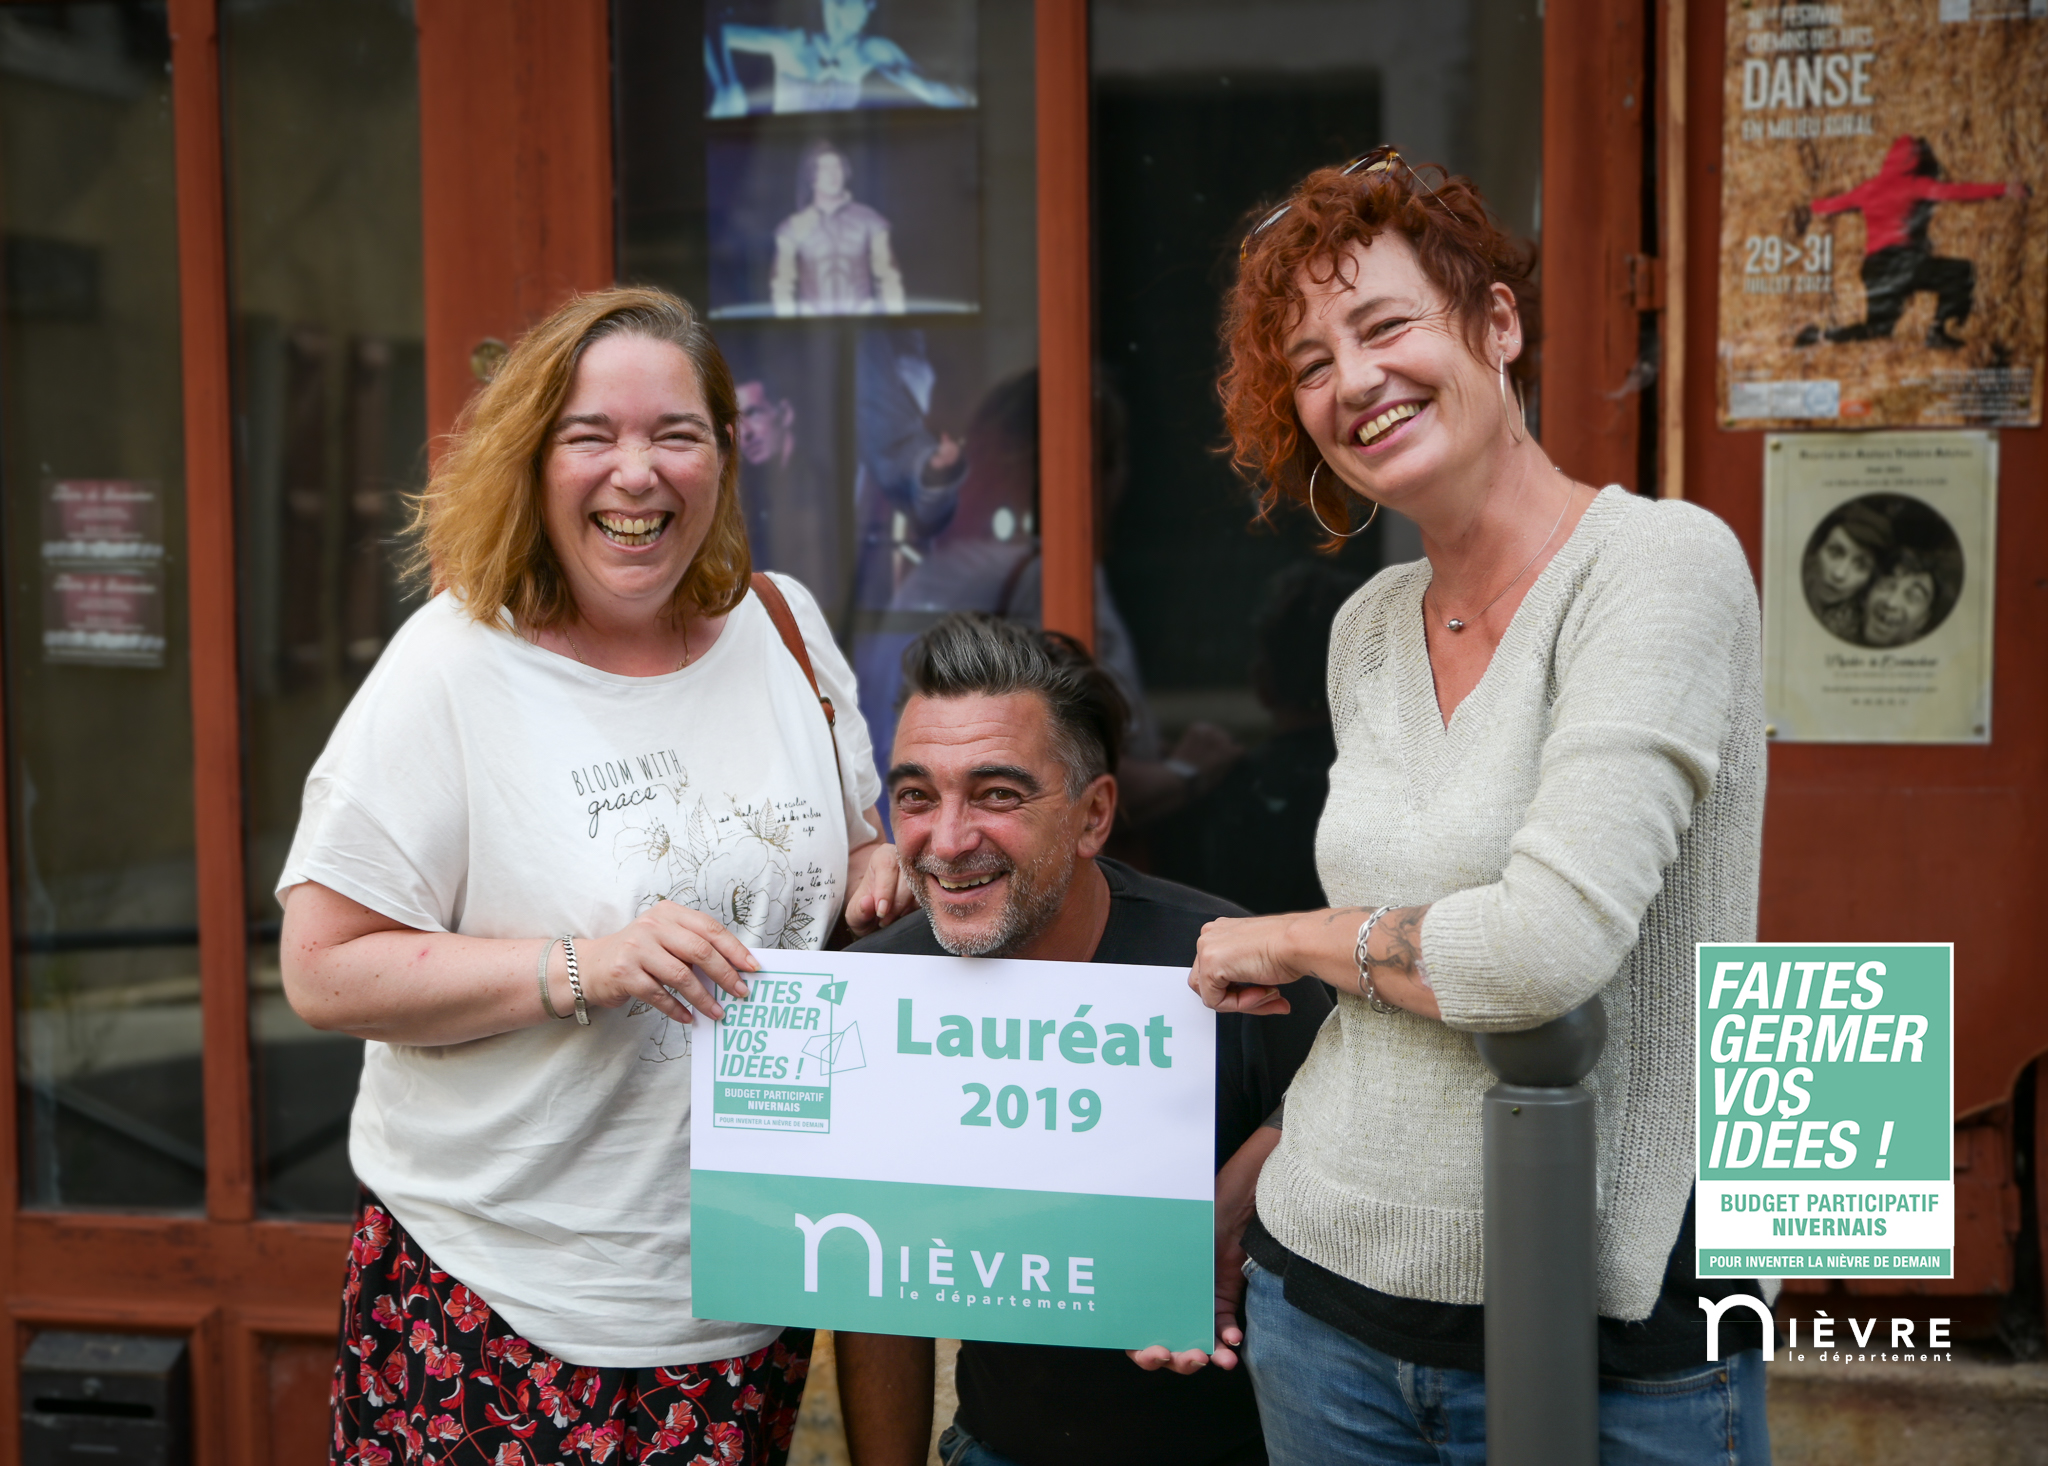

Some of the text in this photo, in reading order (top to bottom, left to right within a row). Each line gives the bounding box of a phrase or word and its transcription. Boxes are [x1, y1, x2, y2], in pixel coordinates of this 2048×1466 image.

[1742, 53, 1876, 111] DANSE
[1744, 233, 1833, 273] 29>31
[571, 749, 682, 796] BLOOM WITH
[588, 786, 657, 839] grace
[720, 979, 803, 1005] ITES
[721, 1004, 821, 1031] GERMER
[722, 1028, 769, 1053] VOS
[896, 997, 1173, 1069] Lauréat
[720, 1052, 789, 1080] IDÉES
[724, 1087, 825, 1102] BUDGET PARTICIPATIF
[747, 1100, 801, 1113] NIVERNAIS
[960, 1082, 1102, 1133] 2019
[719, 1116, 735, 1124] POUR
[736, 1117, 763, 1125] INVENTER
[772, 1118, 792, 1127] NIÈVRE
[802, 1121, 824, 1129] DEMAIN
[900, 1286, 1095, 1312] le département
